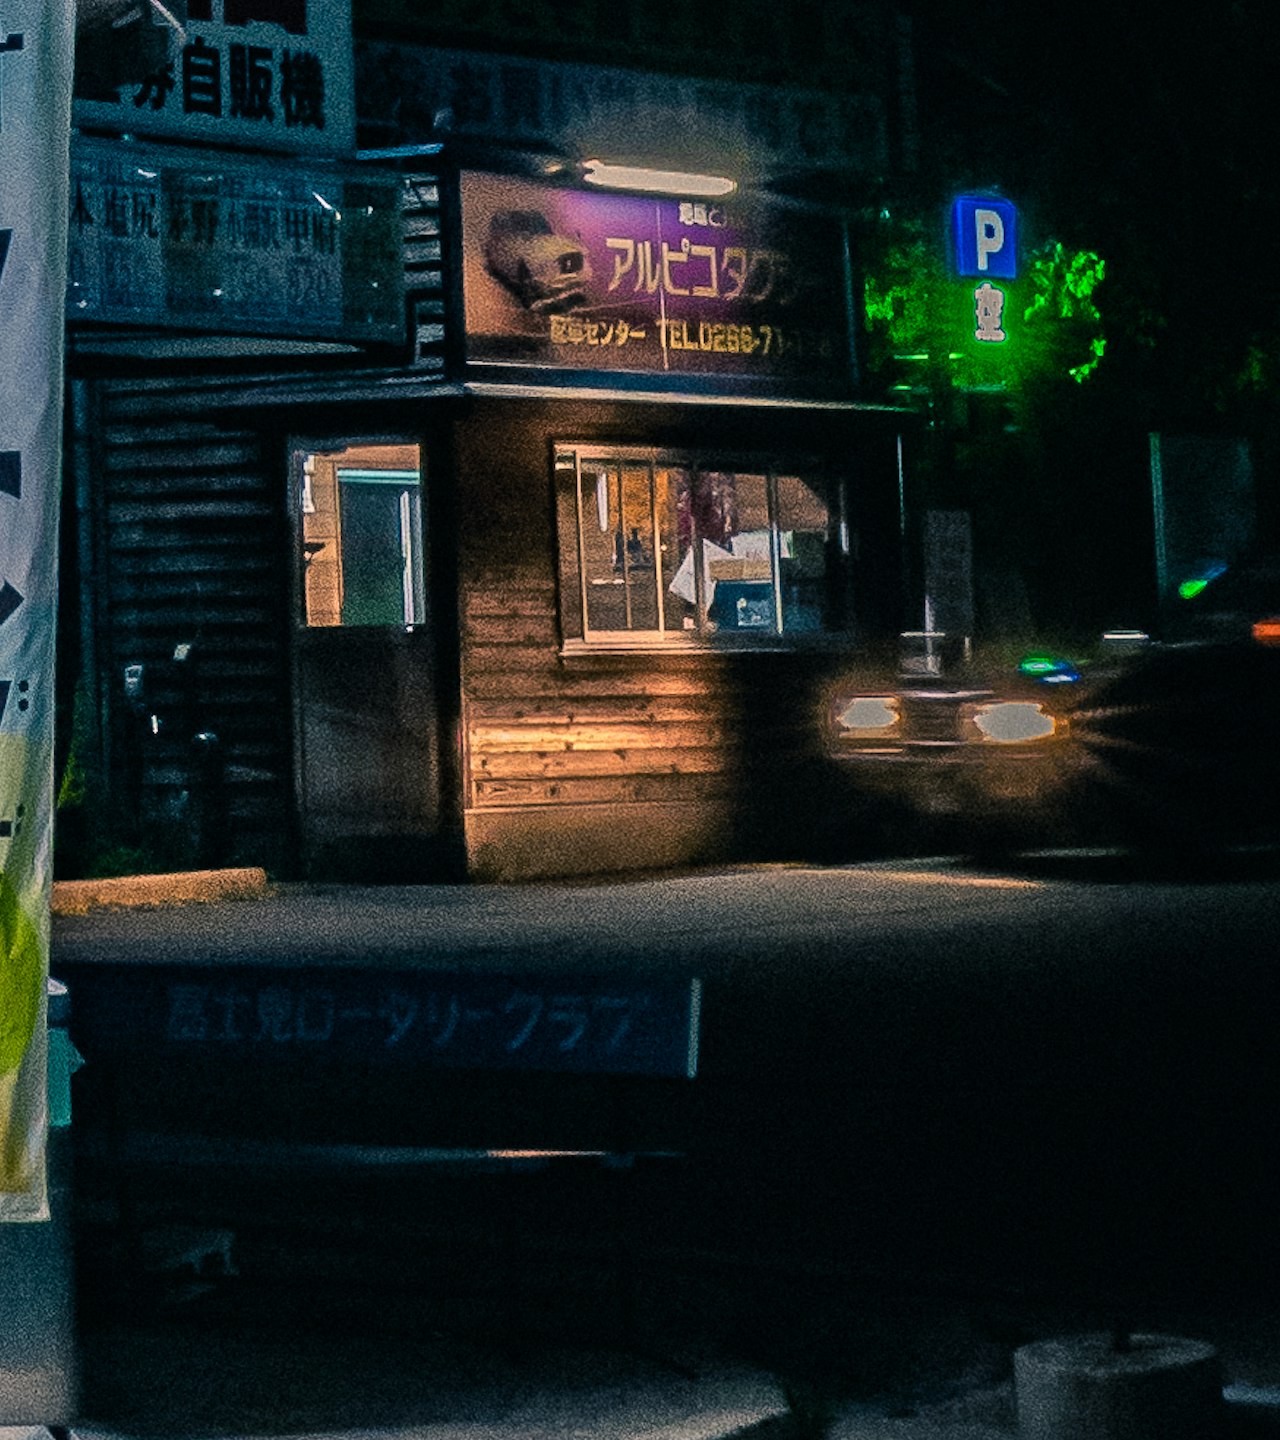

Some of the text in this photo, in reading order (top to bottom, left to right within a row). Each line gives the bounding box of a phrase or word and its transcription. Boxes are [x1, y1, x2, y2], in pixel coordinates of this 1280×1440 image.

[605, 237, 822, 304] アルピコタク
[975, 209, 1005, 271] P
